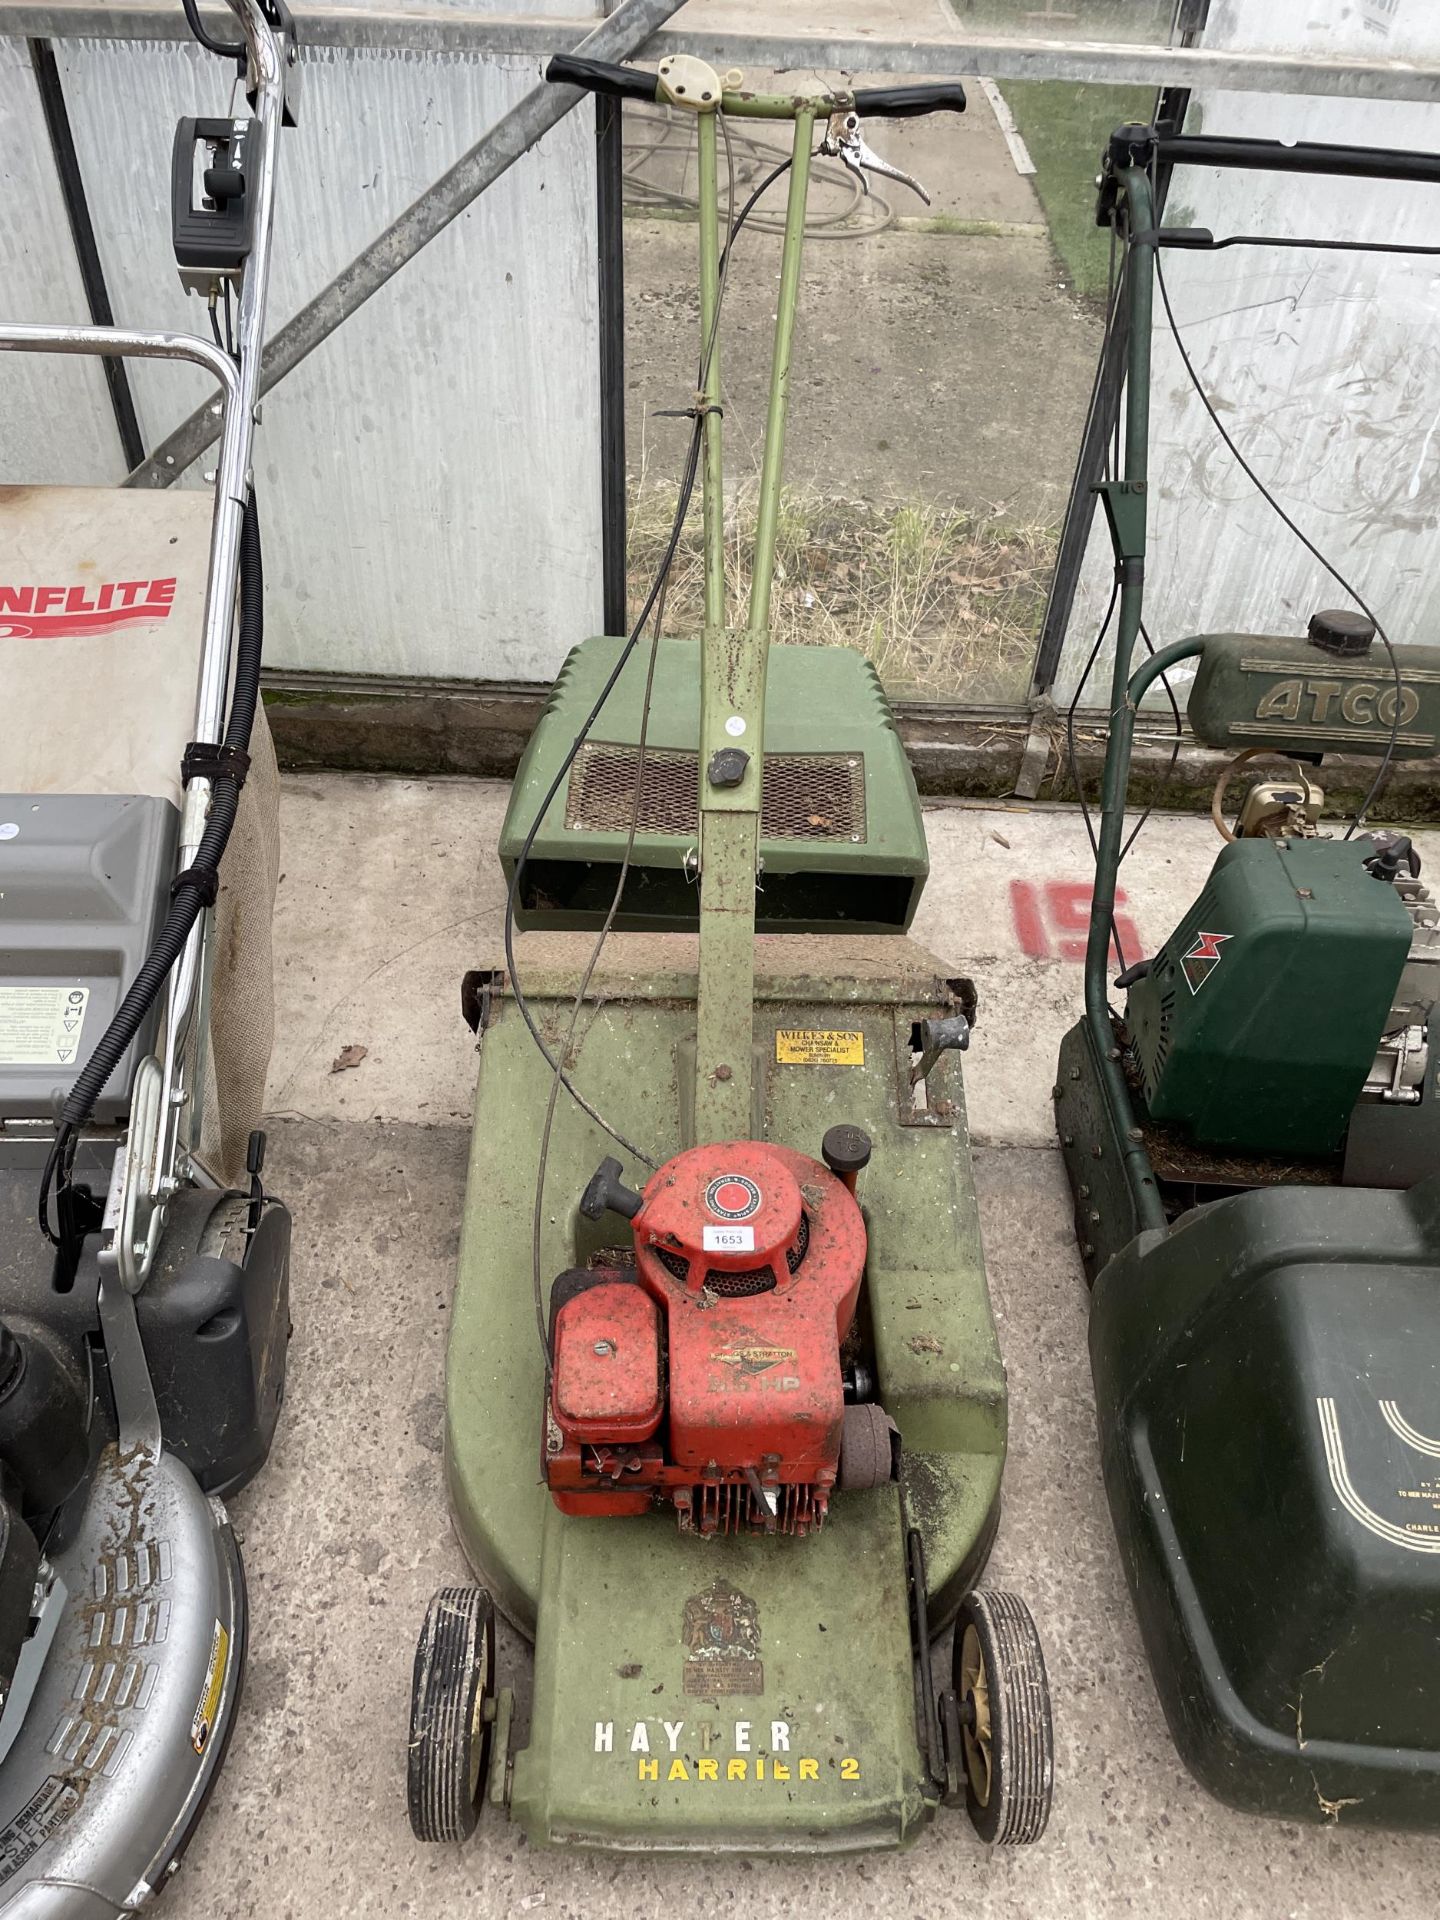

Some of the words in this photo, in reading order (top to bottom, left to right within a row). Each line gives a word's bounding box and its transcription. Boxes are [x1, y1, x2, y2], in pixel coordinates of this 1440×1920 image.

[1256, 680, 1419, 727] ATCO
[780, 1031, 825, 1040] WILKES
[826, 1032, 835, 1040] &
[836, 1032, 859, 1041] SON
[715, 1235, 743, 1245] 1653
[753, 1350, 793, 1359] STRATTON
[761, 1376, 801, 1393] HP
[594, 1721, 791, 1752] HAYTER
[638, 1758, 820, 1781] HARRIER
[840, 1758, 861, 1780] 2
[15, 1782, 57, 1830] DEMARRAGE
[4, 1812, 44, 1859] STEP
